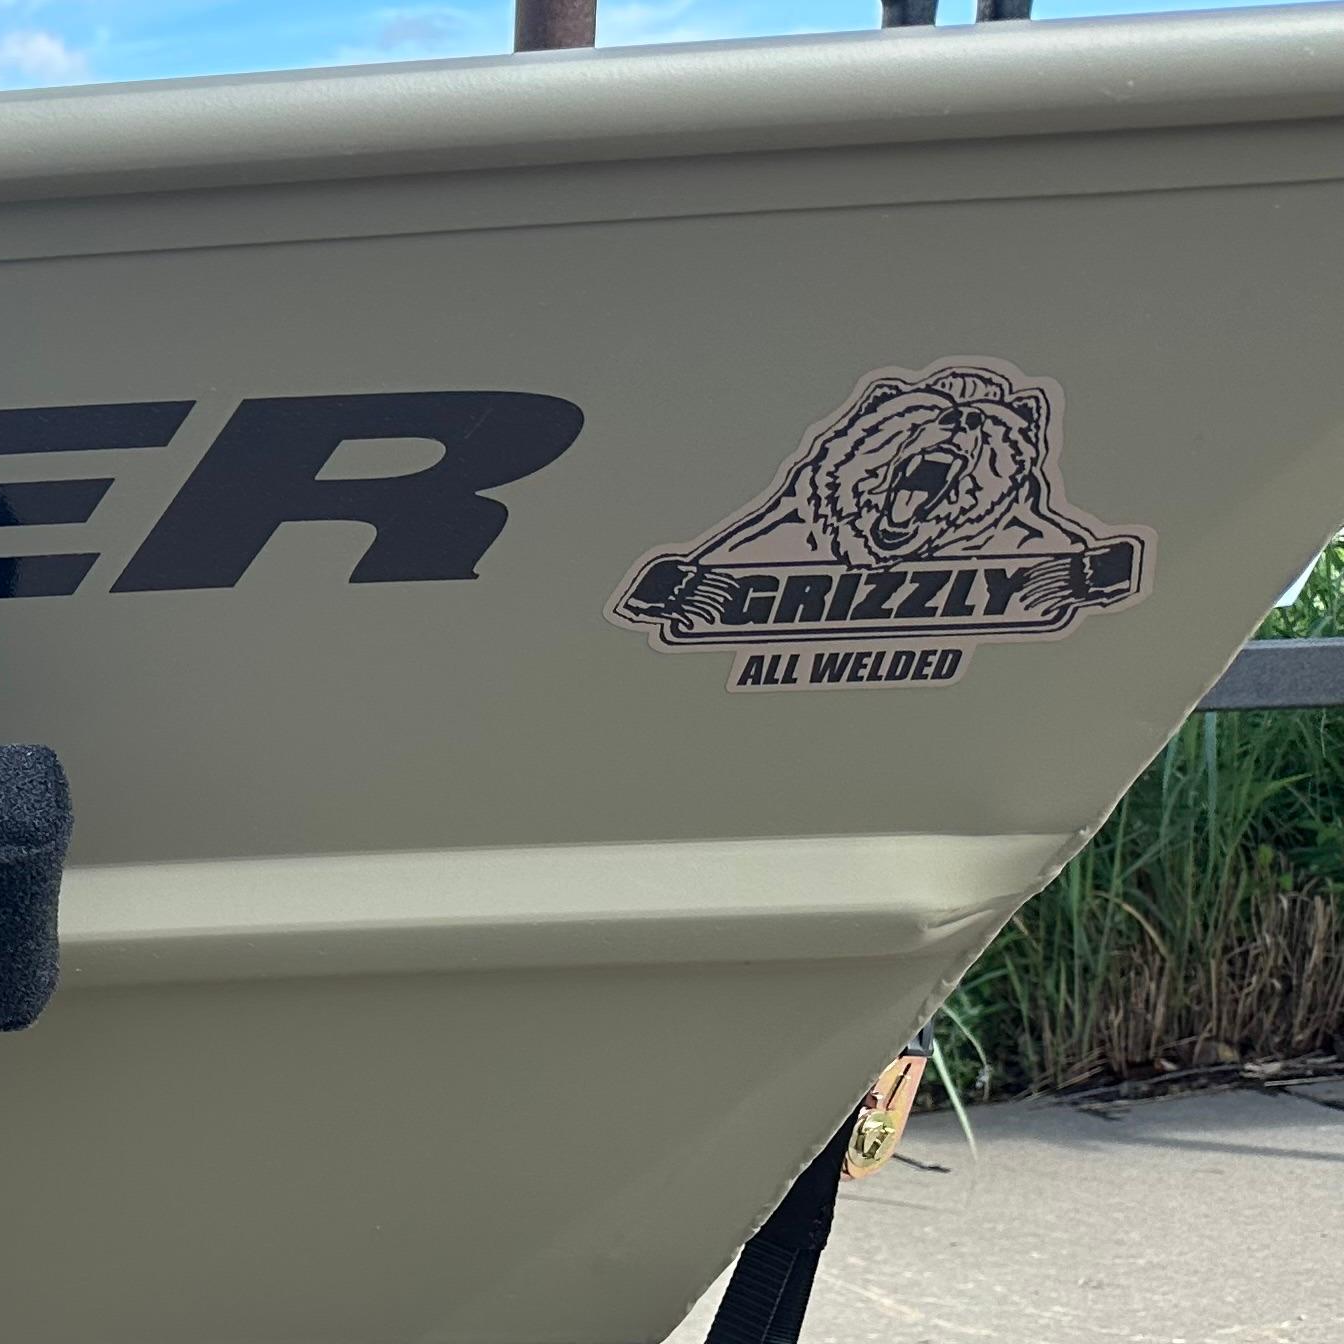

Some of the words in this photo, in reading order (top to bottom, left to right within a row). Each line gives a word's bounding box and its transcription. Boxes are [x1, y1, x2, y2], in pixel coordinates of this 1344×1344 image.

[720, 566, 1028, 626] GRIZZLY
[736, 653, 799, 686] ALL
[808, 648, 964, 684] WELDED
